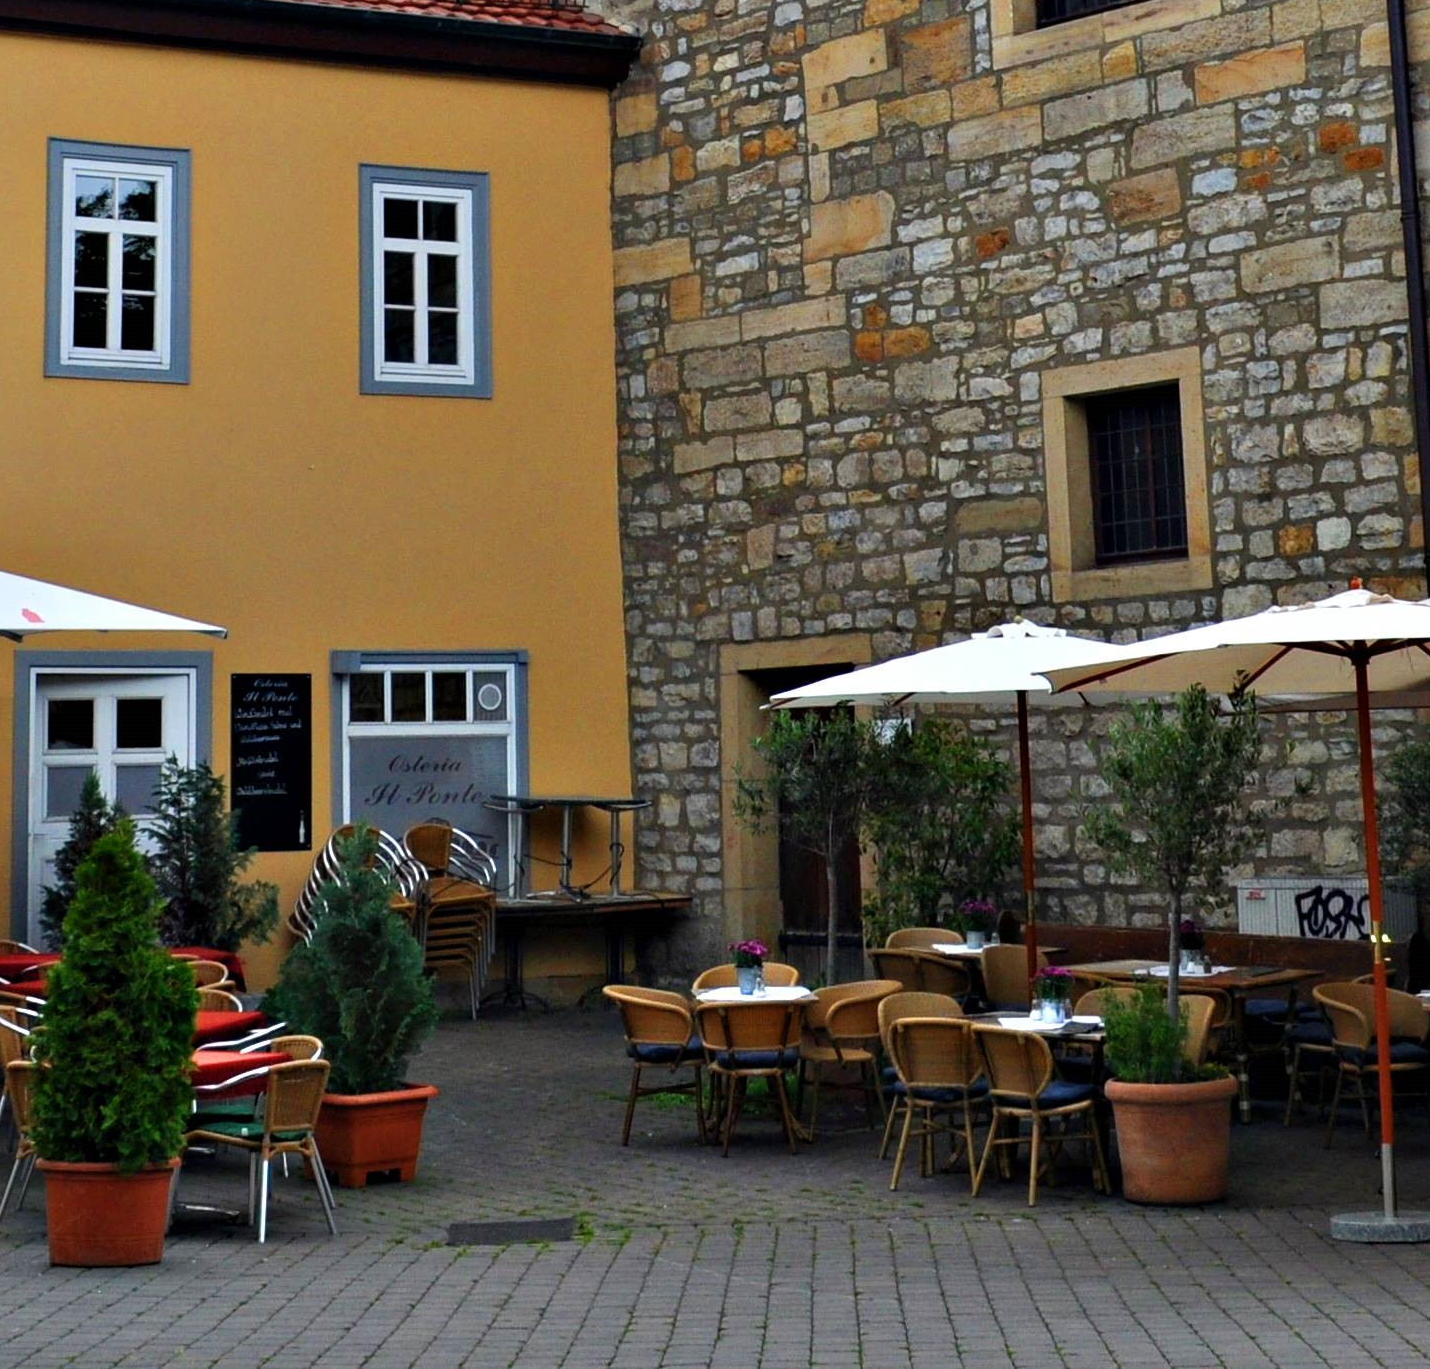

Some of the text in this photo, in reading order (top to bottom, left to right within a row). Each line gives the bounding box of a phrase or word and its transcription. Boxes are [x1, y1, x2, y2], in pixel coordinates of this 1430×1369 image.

[388, 754, 465, 772] Osteria
[364, 782, 484, 807] Il Ponte
